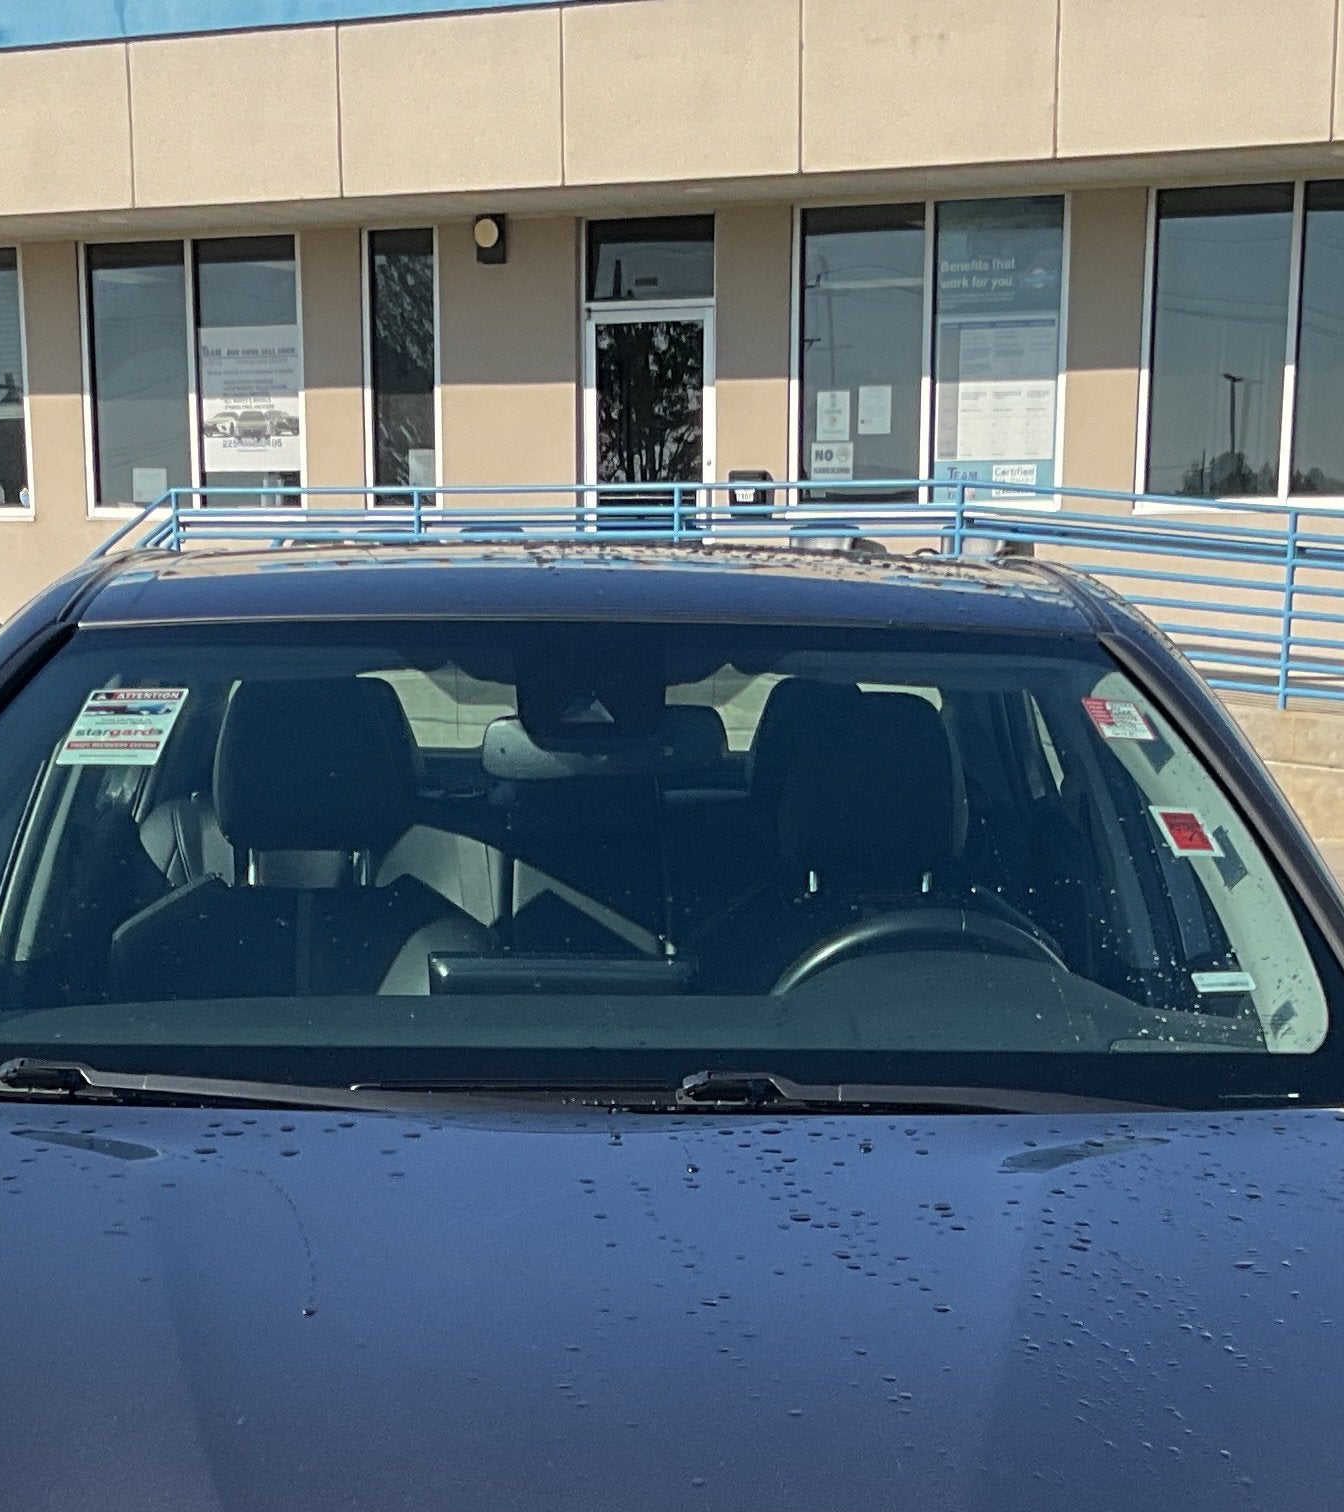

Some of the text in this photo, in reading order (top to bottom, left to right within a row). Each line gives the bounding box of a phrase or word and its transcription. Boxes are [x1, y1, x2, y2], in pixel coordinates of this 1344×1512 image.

[941, 276, 969, 288] work
[972, 276, 988, 287] for
[815, 449, 834, 461] NO
[117, 691, 180, 699] ATTENTION
